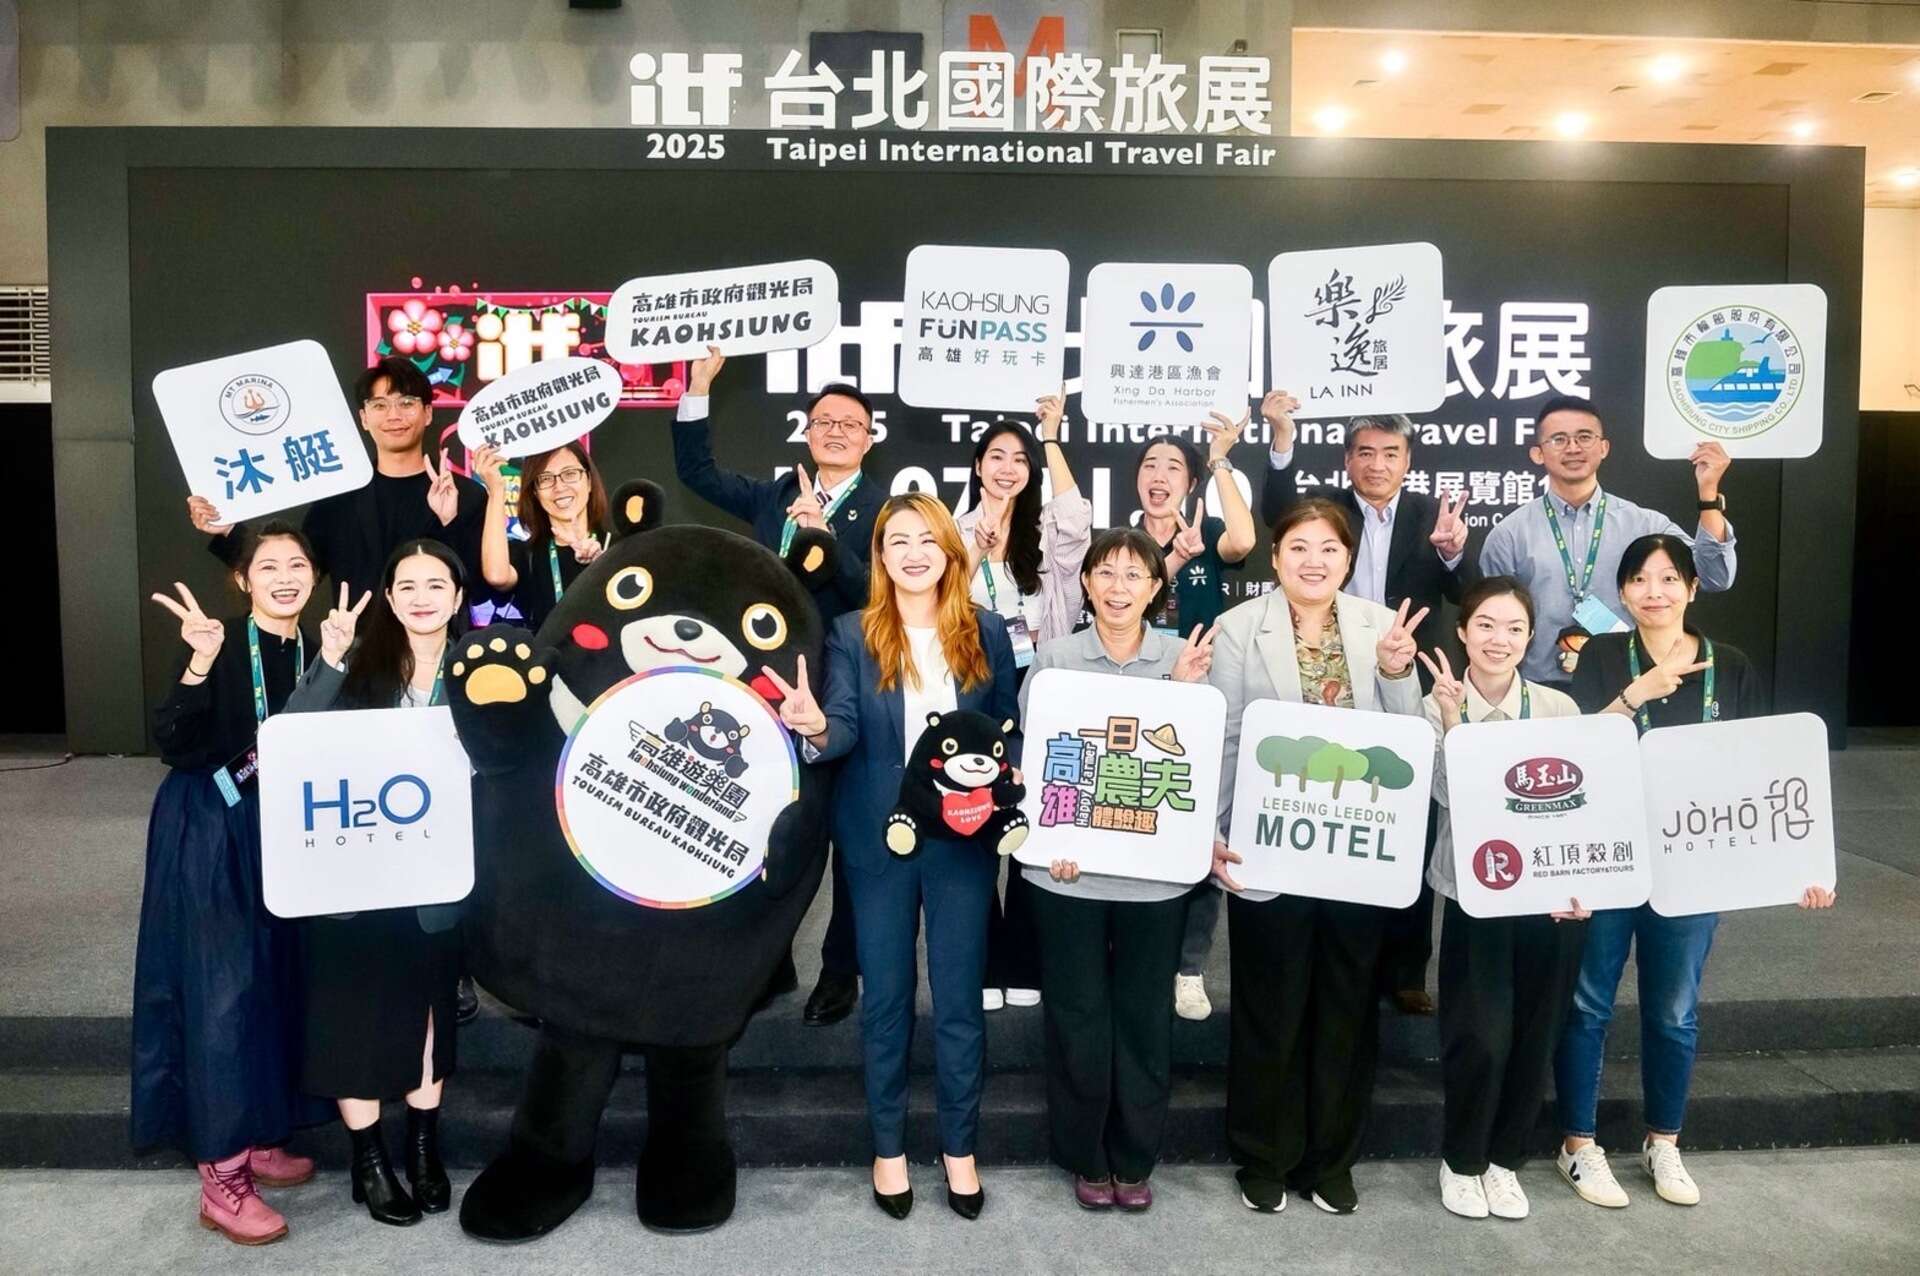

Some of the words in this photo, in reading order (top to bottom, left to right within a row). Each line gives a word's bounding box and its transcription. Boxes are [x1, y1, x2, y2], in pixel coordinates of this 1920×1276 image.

[629, 52, 743, 126] itf
[764, 49, 1273, 134] 台北國際旅展
[646, 134, 725, 160] 2025
[766, 138, 867, 167] Taipei
[880, 138, 1093, 165] International
[1105, 141, 1203, 166] Travel
[1216, 143, 1276, 167] Fair
[632, 277, 813, 314] 高雄市政府觀光局
[921, 291, 1049, 315] KAOHSIUNG
[630, 311, 812, 347] KAOHSIUNG
[633, 314, 671, 324] TOURISM
[673, 311, 708, 321] BUREAU
[918, 346, 1046, 367] 高雄好玩卡
[1372, 339, 1388, 370] 旅居
[1110, 364, 1221, 381] 興達港區漁會
[471, 366, 601, 424] 高雄市政府觀光局
[1114, 386, 1140, 397] Xing
[1148, 386, 1165, 396] Da
[1174, 387, 1216, 397] Harbor
[1310, 386, 1334, 399] LA
[1341, 383, 1373, 397] INN
[480, 416, 515, 433] TOURISM
[516, 403, 548, 420] BUREAU
[484, 392, 611, 448] KAOHSIUNG
[1672, 380, 1708, 428] KAOHSIUNG
[1708, 422, 1730, 434] CITY
[1732, 412, 1776, 434] SHIPPING
[214, 429, 344, 500] 沐艇
[628, 748, 680, 787] Kaohsiung
[635, 730, 751, 810] 高雄遊樂園
[1081, 742, 1097, 786] Farmer
[1514, 764, 1577, 791] 馬玉山
[1095, 751, 1195, 812] 農夫
[580, 753, 750, 867] 高雄市政府觀光局
[1075, 789, 1092, 828] Happy
[1262, 797, 1328, 816] LEESING
[1335, 805, 1397, 825] LEEDON
[1515, 799, 1578, 812] GREENMAX
[305, 830, 431, 848] HOTEL
[572, 775, 624, 812] TOURISM
[624, 808, 672, 840] BUREAU
[671, 835, 736, 879] KAOHSIUNG
[1256, 813, 1396, 862] MOTEL
[1532, 841, 1633, 867] 紅頂穀創
[1664, 835, 1758, 854] HOTEL
[1533, 869, 1548, 878] RED
[1550, 867, 1570, 877] BARN
